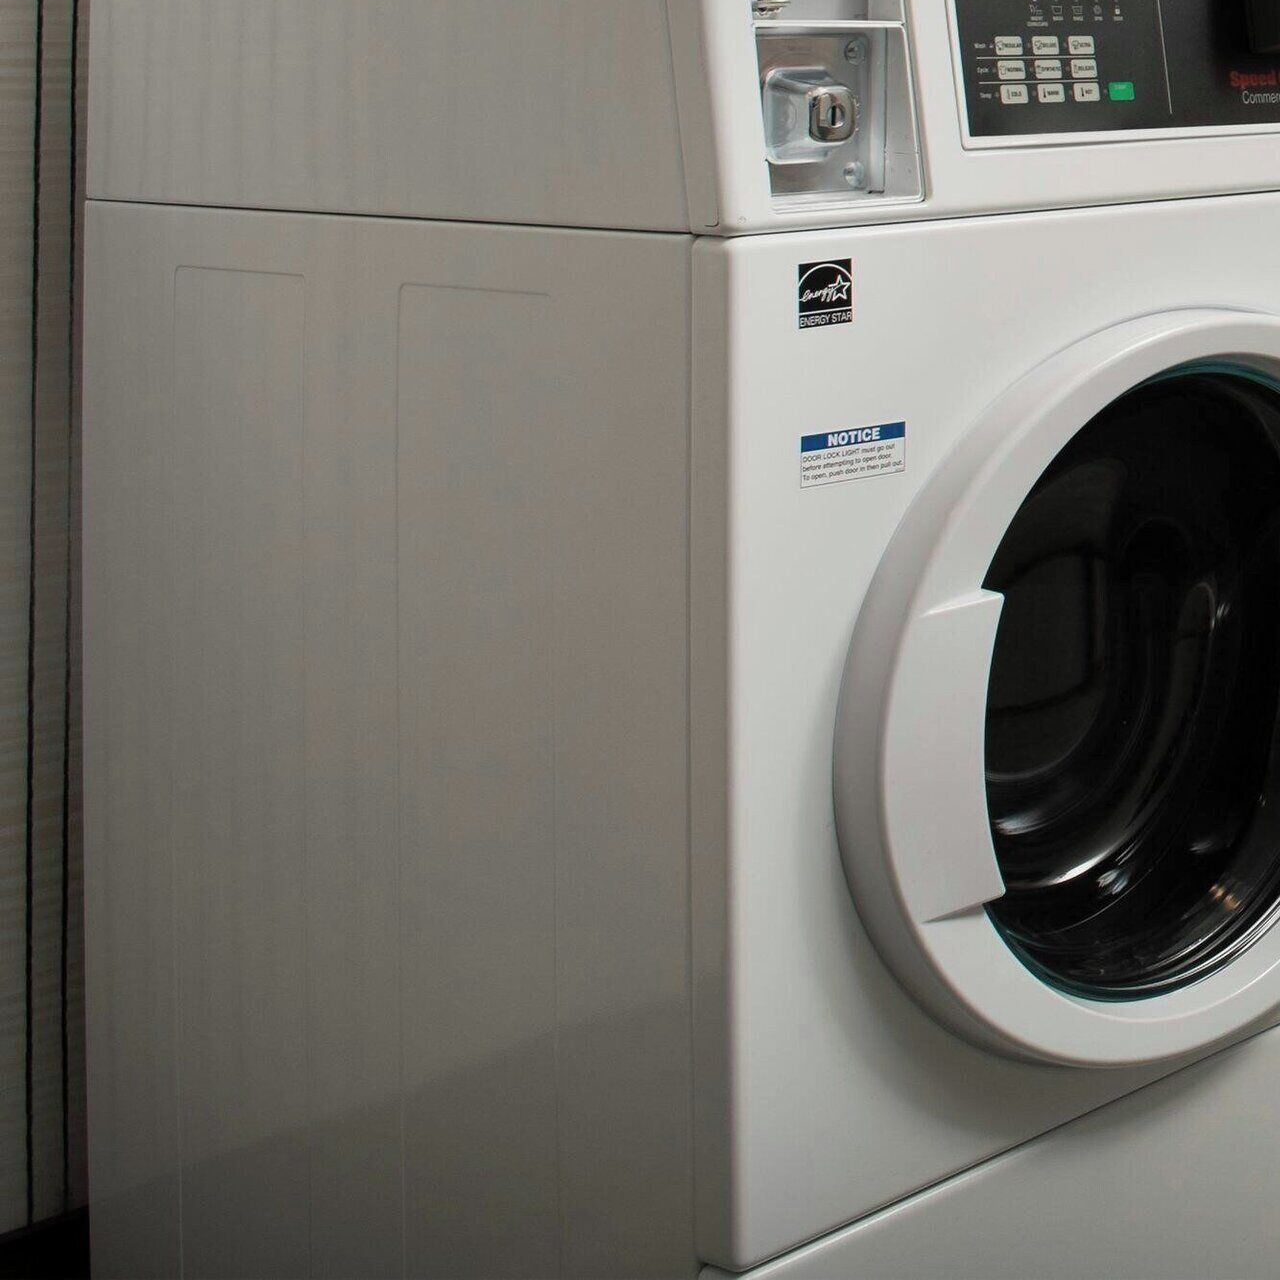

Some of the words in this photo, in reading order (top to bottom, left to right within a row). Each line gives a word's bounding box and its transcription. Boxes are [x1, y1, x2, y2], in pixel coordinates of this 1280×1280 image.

[1230, 69, 1276, 89] Speed
[800, 314, 831, 327] ENERGY
[831, 311, 852, 323] STAR
[827, 427, 881, 447] NOTICE
[802, 455, 821, 463] DOOR
[823, 451, 840, 460] LOCK
[842, 448, 860, 457] LIGHT
[802, 464, 821, 472] before
[823, 458, 854, 469] attempting
[862, 455, 877, 463] open
[829, 470, 843, 478] push
[845, 467, 858, 475] door
[880, 461, 891, 470] pull
